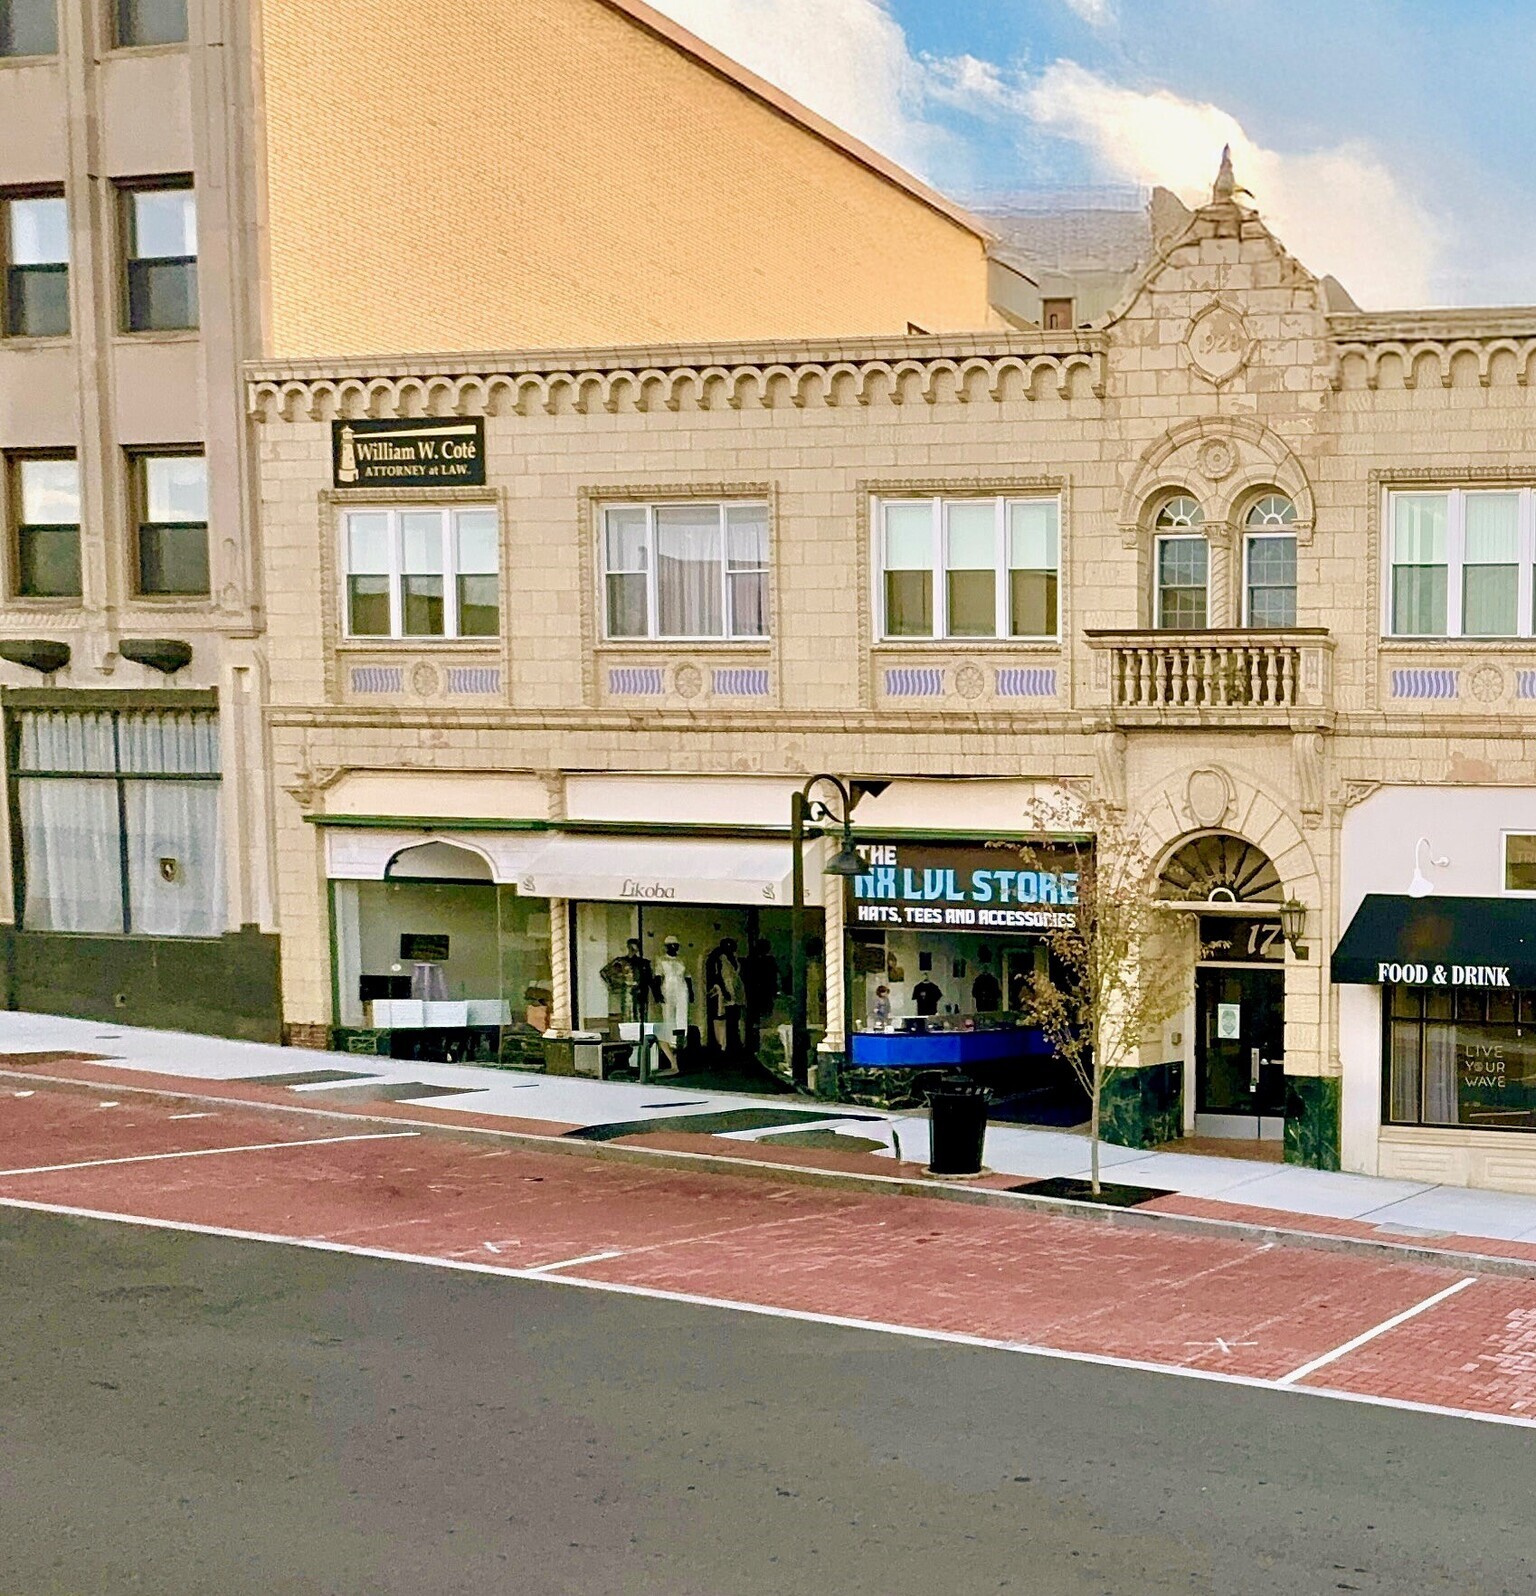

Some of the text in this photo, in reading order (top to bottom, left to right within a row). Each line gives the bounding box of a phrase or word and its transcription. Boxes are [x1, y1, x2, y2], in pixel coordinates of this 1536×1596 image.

[356, 440, 477, 461] William W. Coté
[364, 465, 426, 477] ATTORNEY
[428, 466, 439, 476] at
[855, 844, 897, 865] THE
[619, 879, 675, 898] Likoba
[854, 867, 1079, 905] NX LVL STORE
[858, 905, 1077, 928] HATS, TEES AND ACCESSORIES
[1378, 962, 1511, 987] FOOD & DRINK
[1465, 1045, 1504, 1059] LIVE
[1465, 1060, 1506, 1073] YOUR
[1464, 1075, 1506, 1088] WAVE
